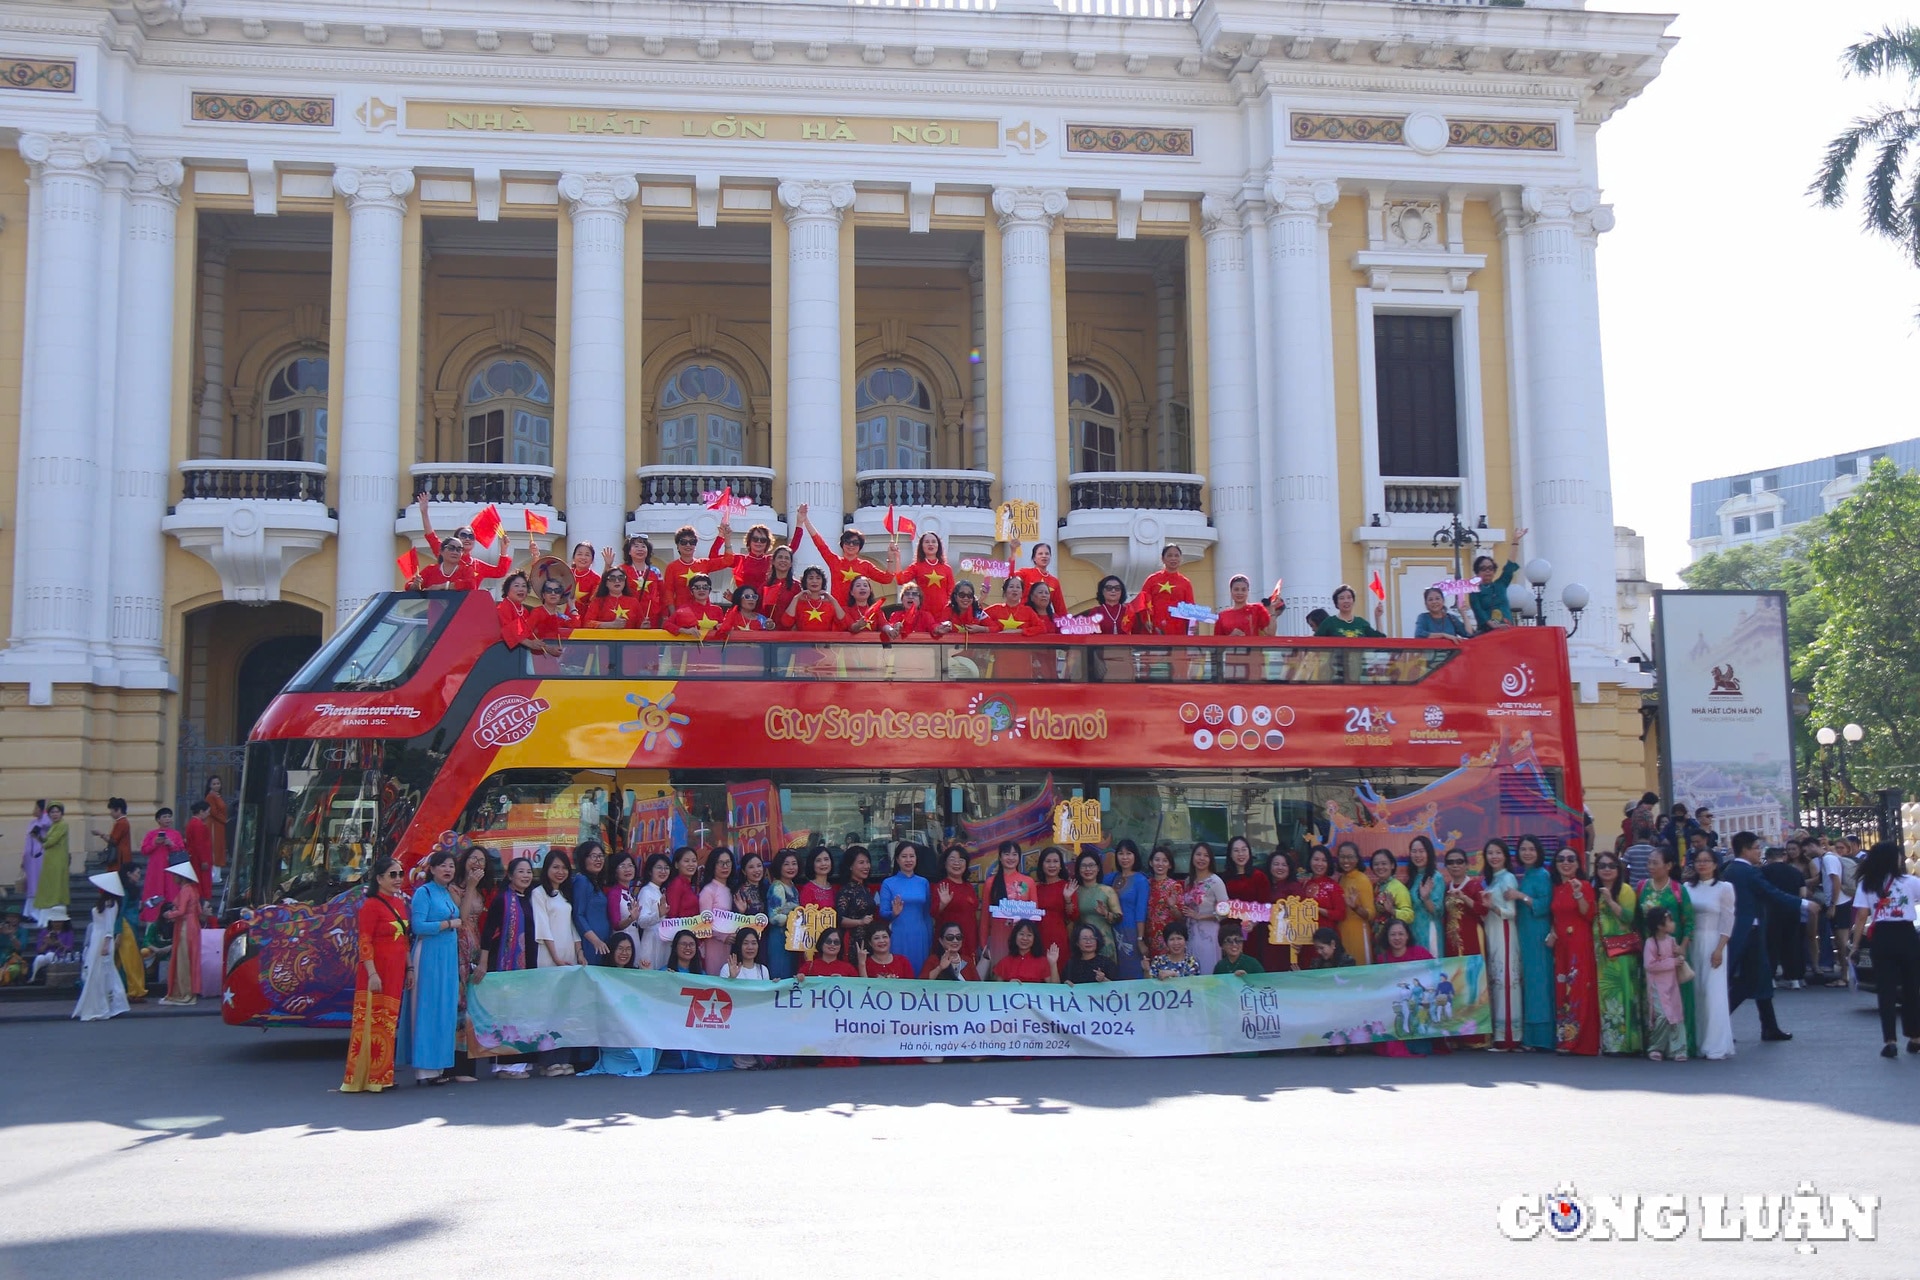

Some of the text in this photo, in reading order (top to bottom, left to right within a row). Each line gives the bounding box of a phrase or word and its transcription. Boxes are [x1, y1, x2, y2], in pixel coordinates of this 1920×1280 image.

[447, 106, 534, 132] NHÀ
[568, 111, 650, 134] HÁT
[801, 117, 857, 141] HÀ
[891, 121, 961, 147] NỘI
[481, 700, 547, 742] OFFICIAL
[1030, 706, 1109, 741] Hanoi
[1345, 707, 1373, 732] 24
[506, 720, 535, 741] TOUR
[522, 848, 541, 864] 06
[661, 917, 699, 928] TINH HOA
[714, 909, 751, 924] TINH HOA
[774, 982, 1194, 1016] LỄ HỘI ÁO DÀI DU LỊCH HÀ NỘI 2024
[835, 1018, 1136, 1036] Hanoi Tourism Ao Dai Festival 2024
[900, 1042, 914, 1051] Hà
[935, 1041, 959, 1052] ngày
[960, 1041, 977, 1050] 4-6
[979, 1040, 1006, 1051] tháng
[1009, 1040, 1022, 1049] 10
[1023, 1041, 1043, 1049] năm
[1045, 1040, 1071, 1049] 2024
